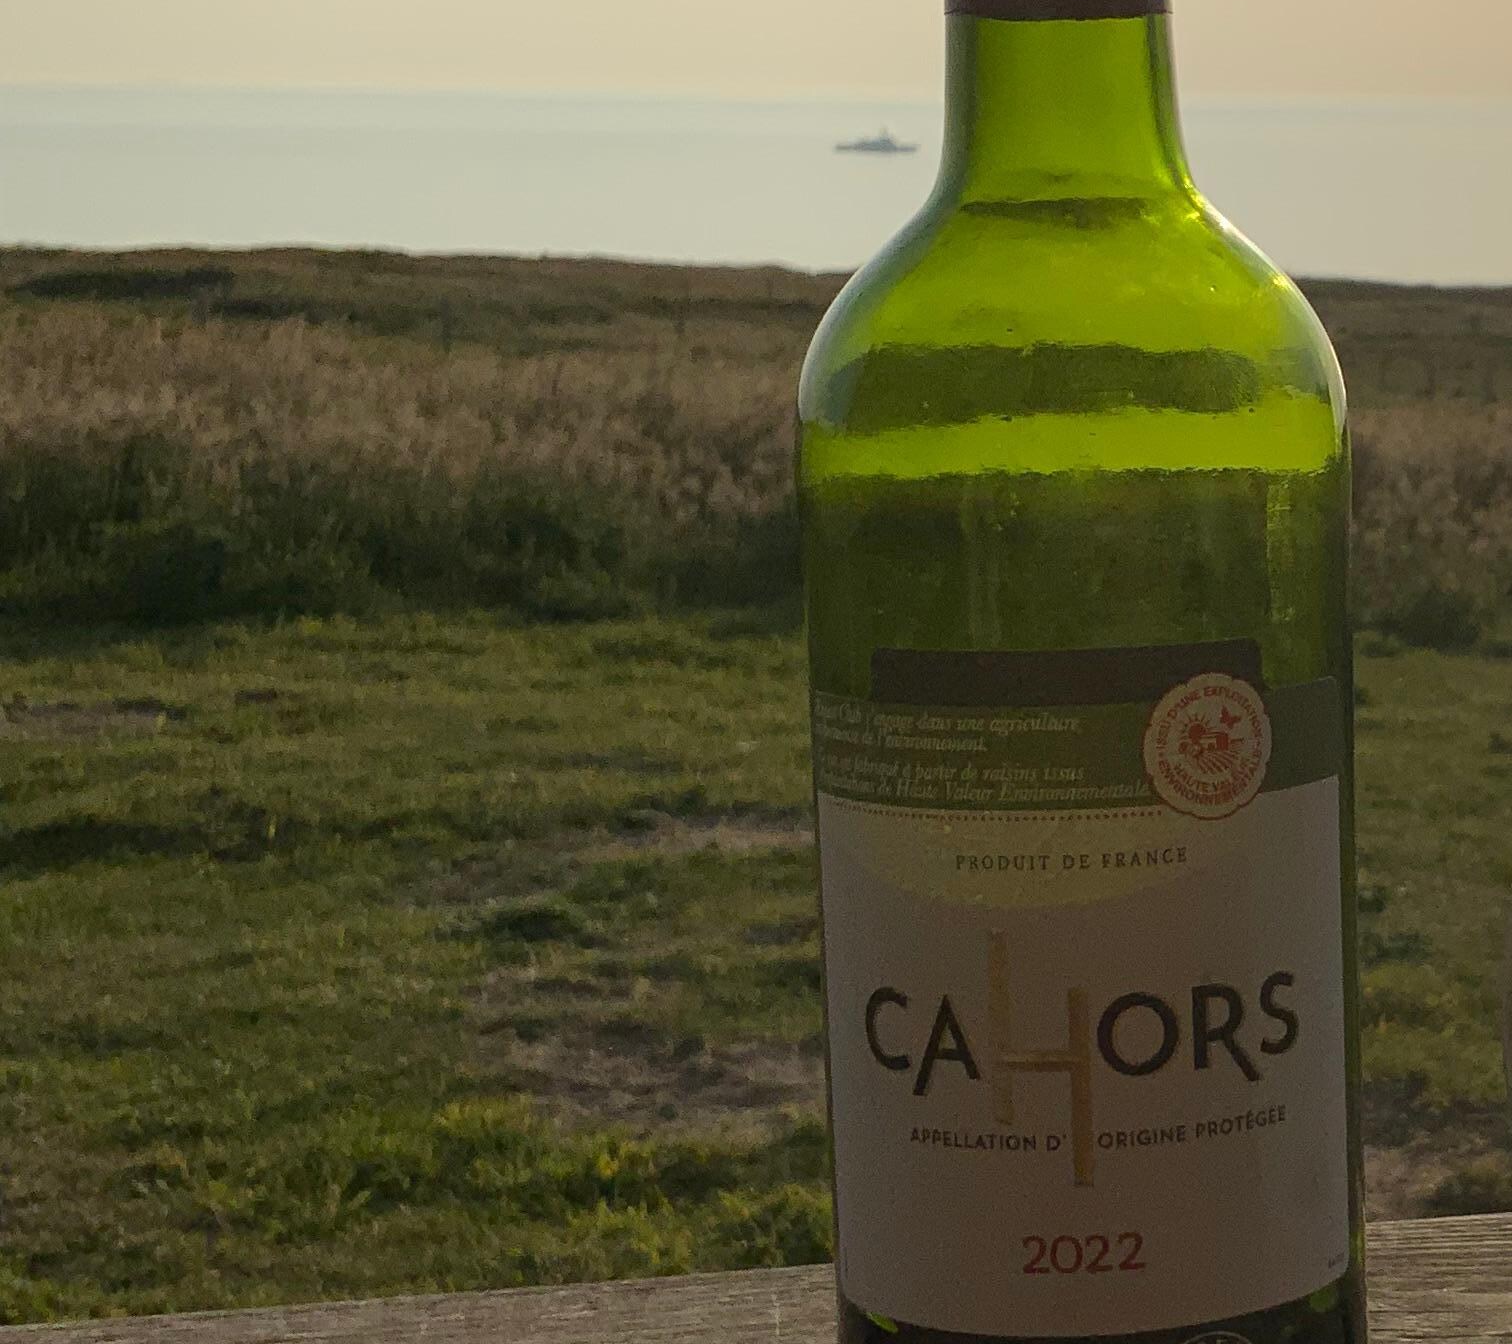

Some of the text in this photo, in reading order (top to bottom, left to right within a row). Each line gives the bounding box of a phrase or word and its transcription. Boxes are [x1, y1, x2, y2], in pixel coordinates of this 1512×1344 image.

[982, 762, 1037, 782] raisins
[1043, 763, 1085, 782] issus
[945, 781, 993, 802] Valeur
[955, 846, 1188, 872] PRODUIT DE FRANCE
[866, 931, 1299, 1187] CAHORS
[910, 1126, 1037, 1151] APPELLATION
[1097, 1124, 1187, 1150] ORIGINE
[1195, 1104, 1287, 1139] PROTÉGÉE
[1022, 1232, 1147, 1275] 2022
